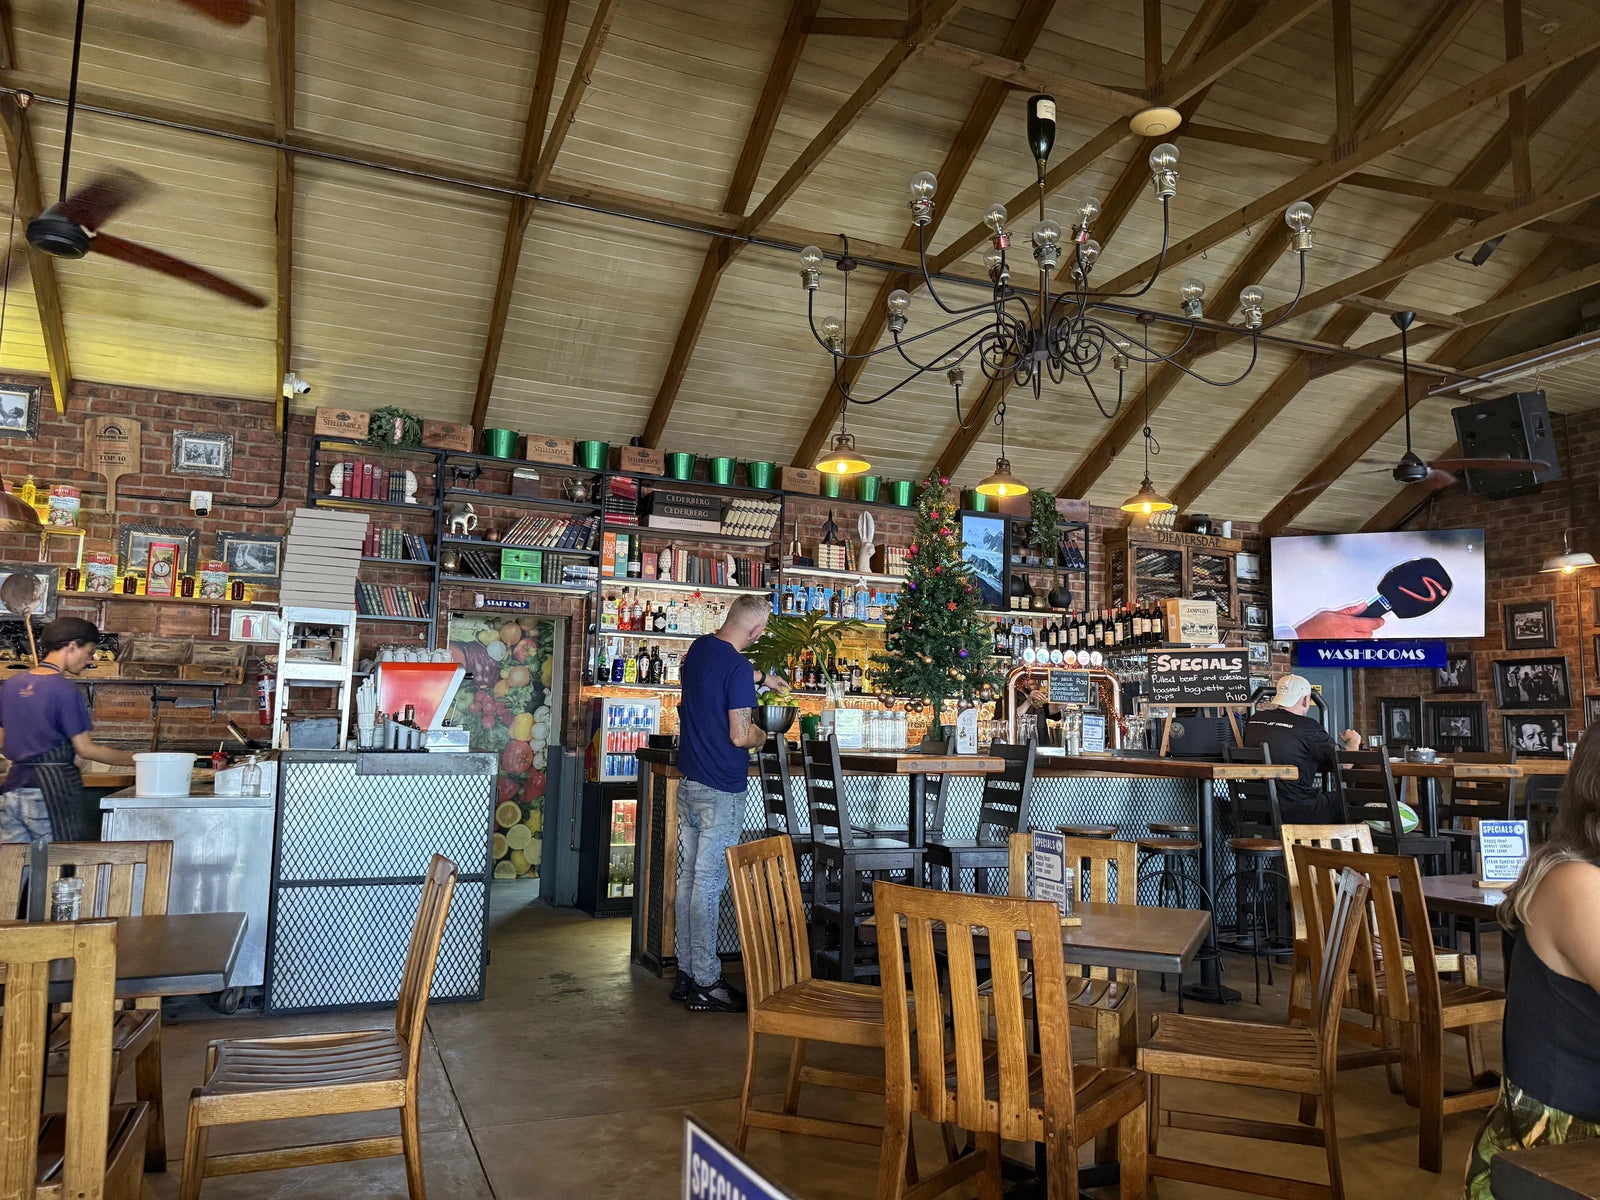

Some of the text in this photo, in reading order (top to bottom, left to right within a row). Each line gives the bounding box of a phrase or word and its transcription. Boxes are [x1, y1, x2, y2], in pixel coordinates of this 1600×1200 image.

[666, 494, 710, 506] CEDERBERG
[664, 506, 709, 518] CEDERBERG
[1158, 530, 1222, 548] DIEMERSDAL
[159, 563, 166, 572] Y
[1317, 648, 1426, 661] WASHROOMS
[1151, 674, 1176, 683] Pulled
[1179, 674, 1199, 682] beef
[1154, 693, 1175, 702] chips
[1225, 692, 1248, 701] R110
[1482, 825, 1514, 834] SPECIALS
[1035, 836, 1056, 850] SPECIALS
[692, 1152, 748, 1200] SPEC
